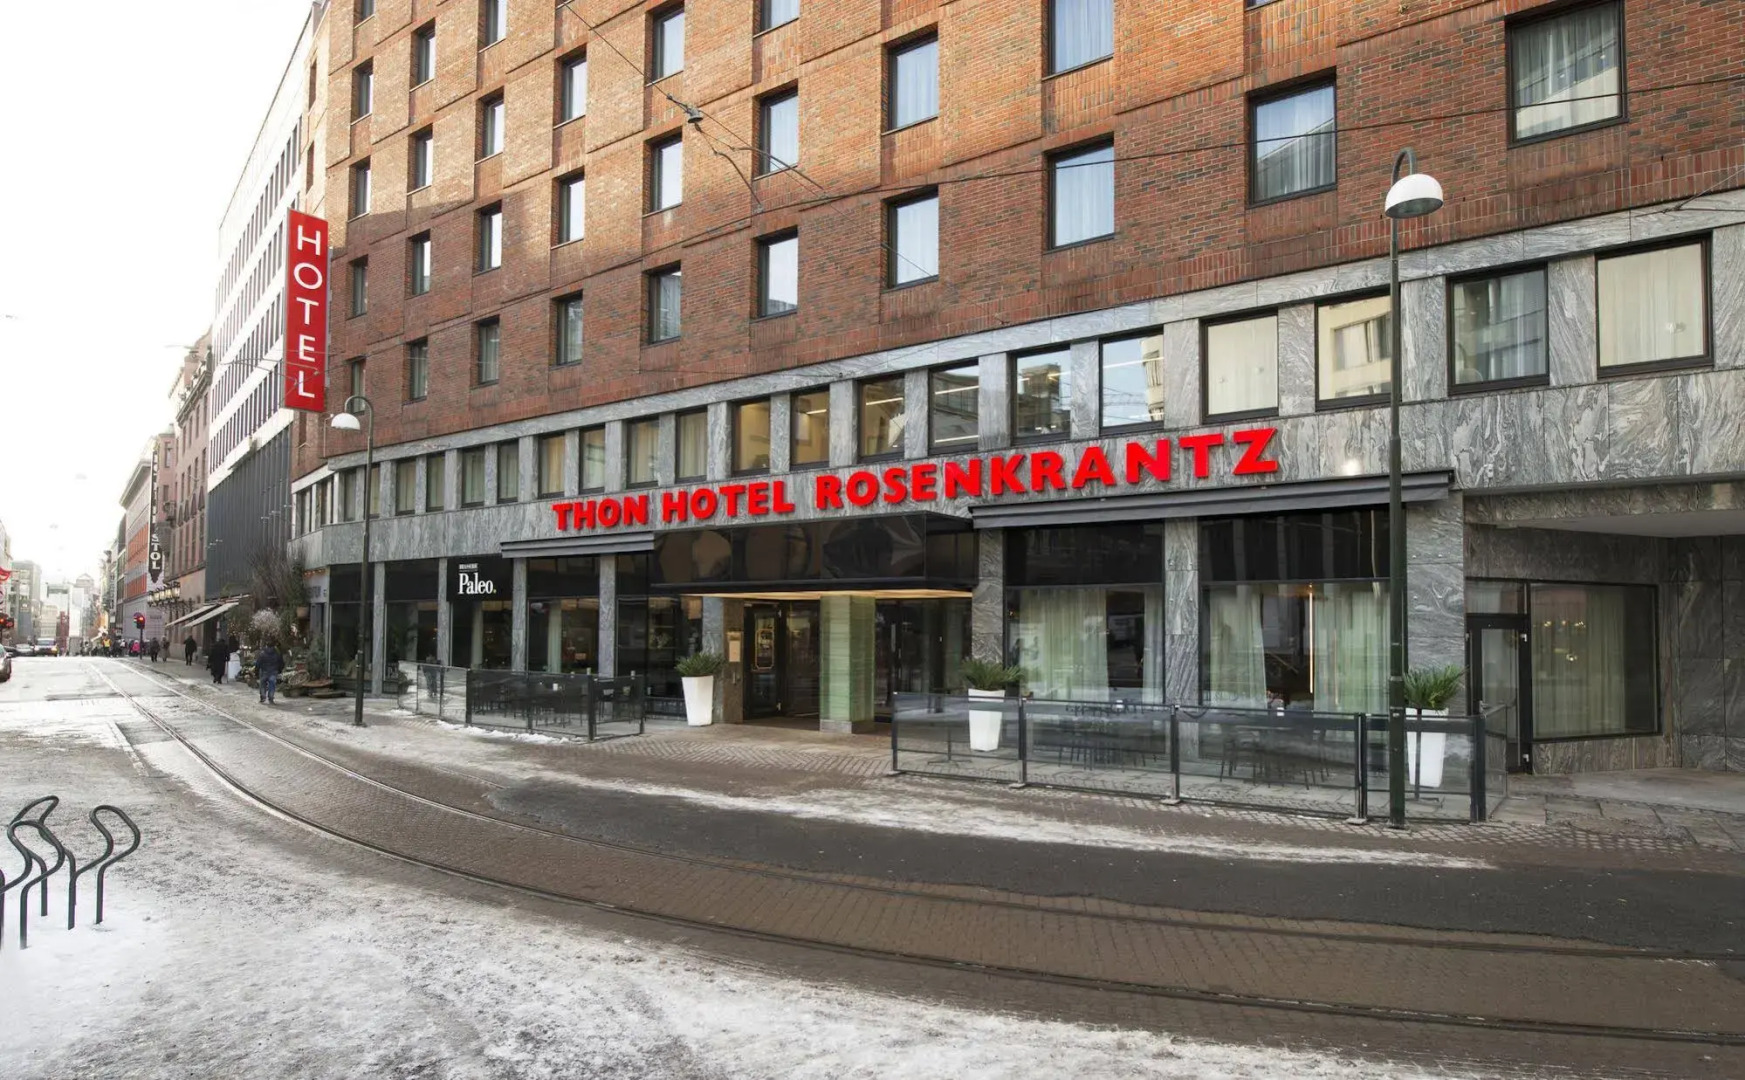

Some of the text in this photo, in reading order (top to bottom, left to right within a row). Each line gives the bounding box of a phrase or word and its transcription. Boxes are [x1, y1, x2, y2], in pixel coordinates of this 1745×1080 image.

[294, 225, 323, 398] HOTEL
[553, 427, 1279, 531] THON HOTEL ROSENKRANTZ
